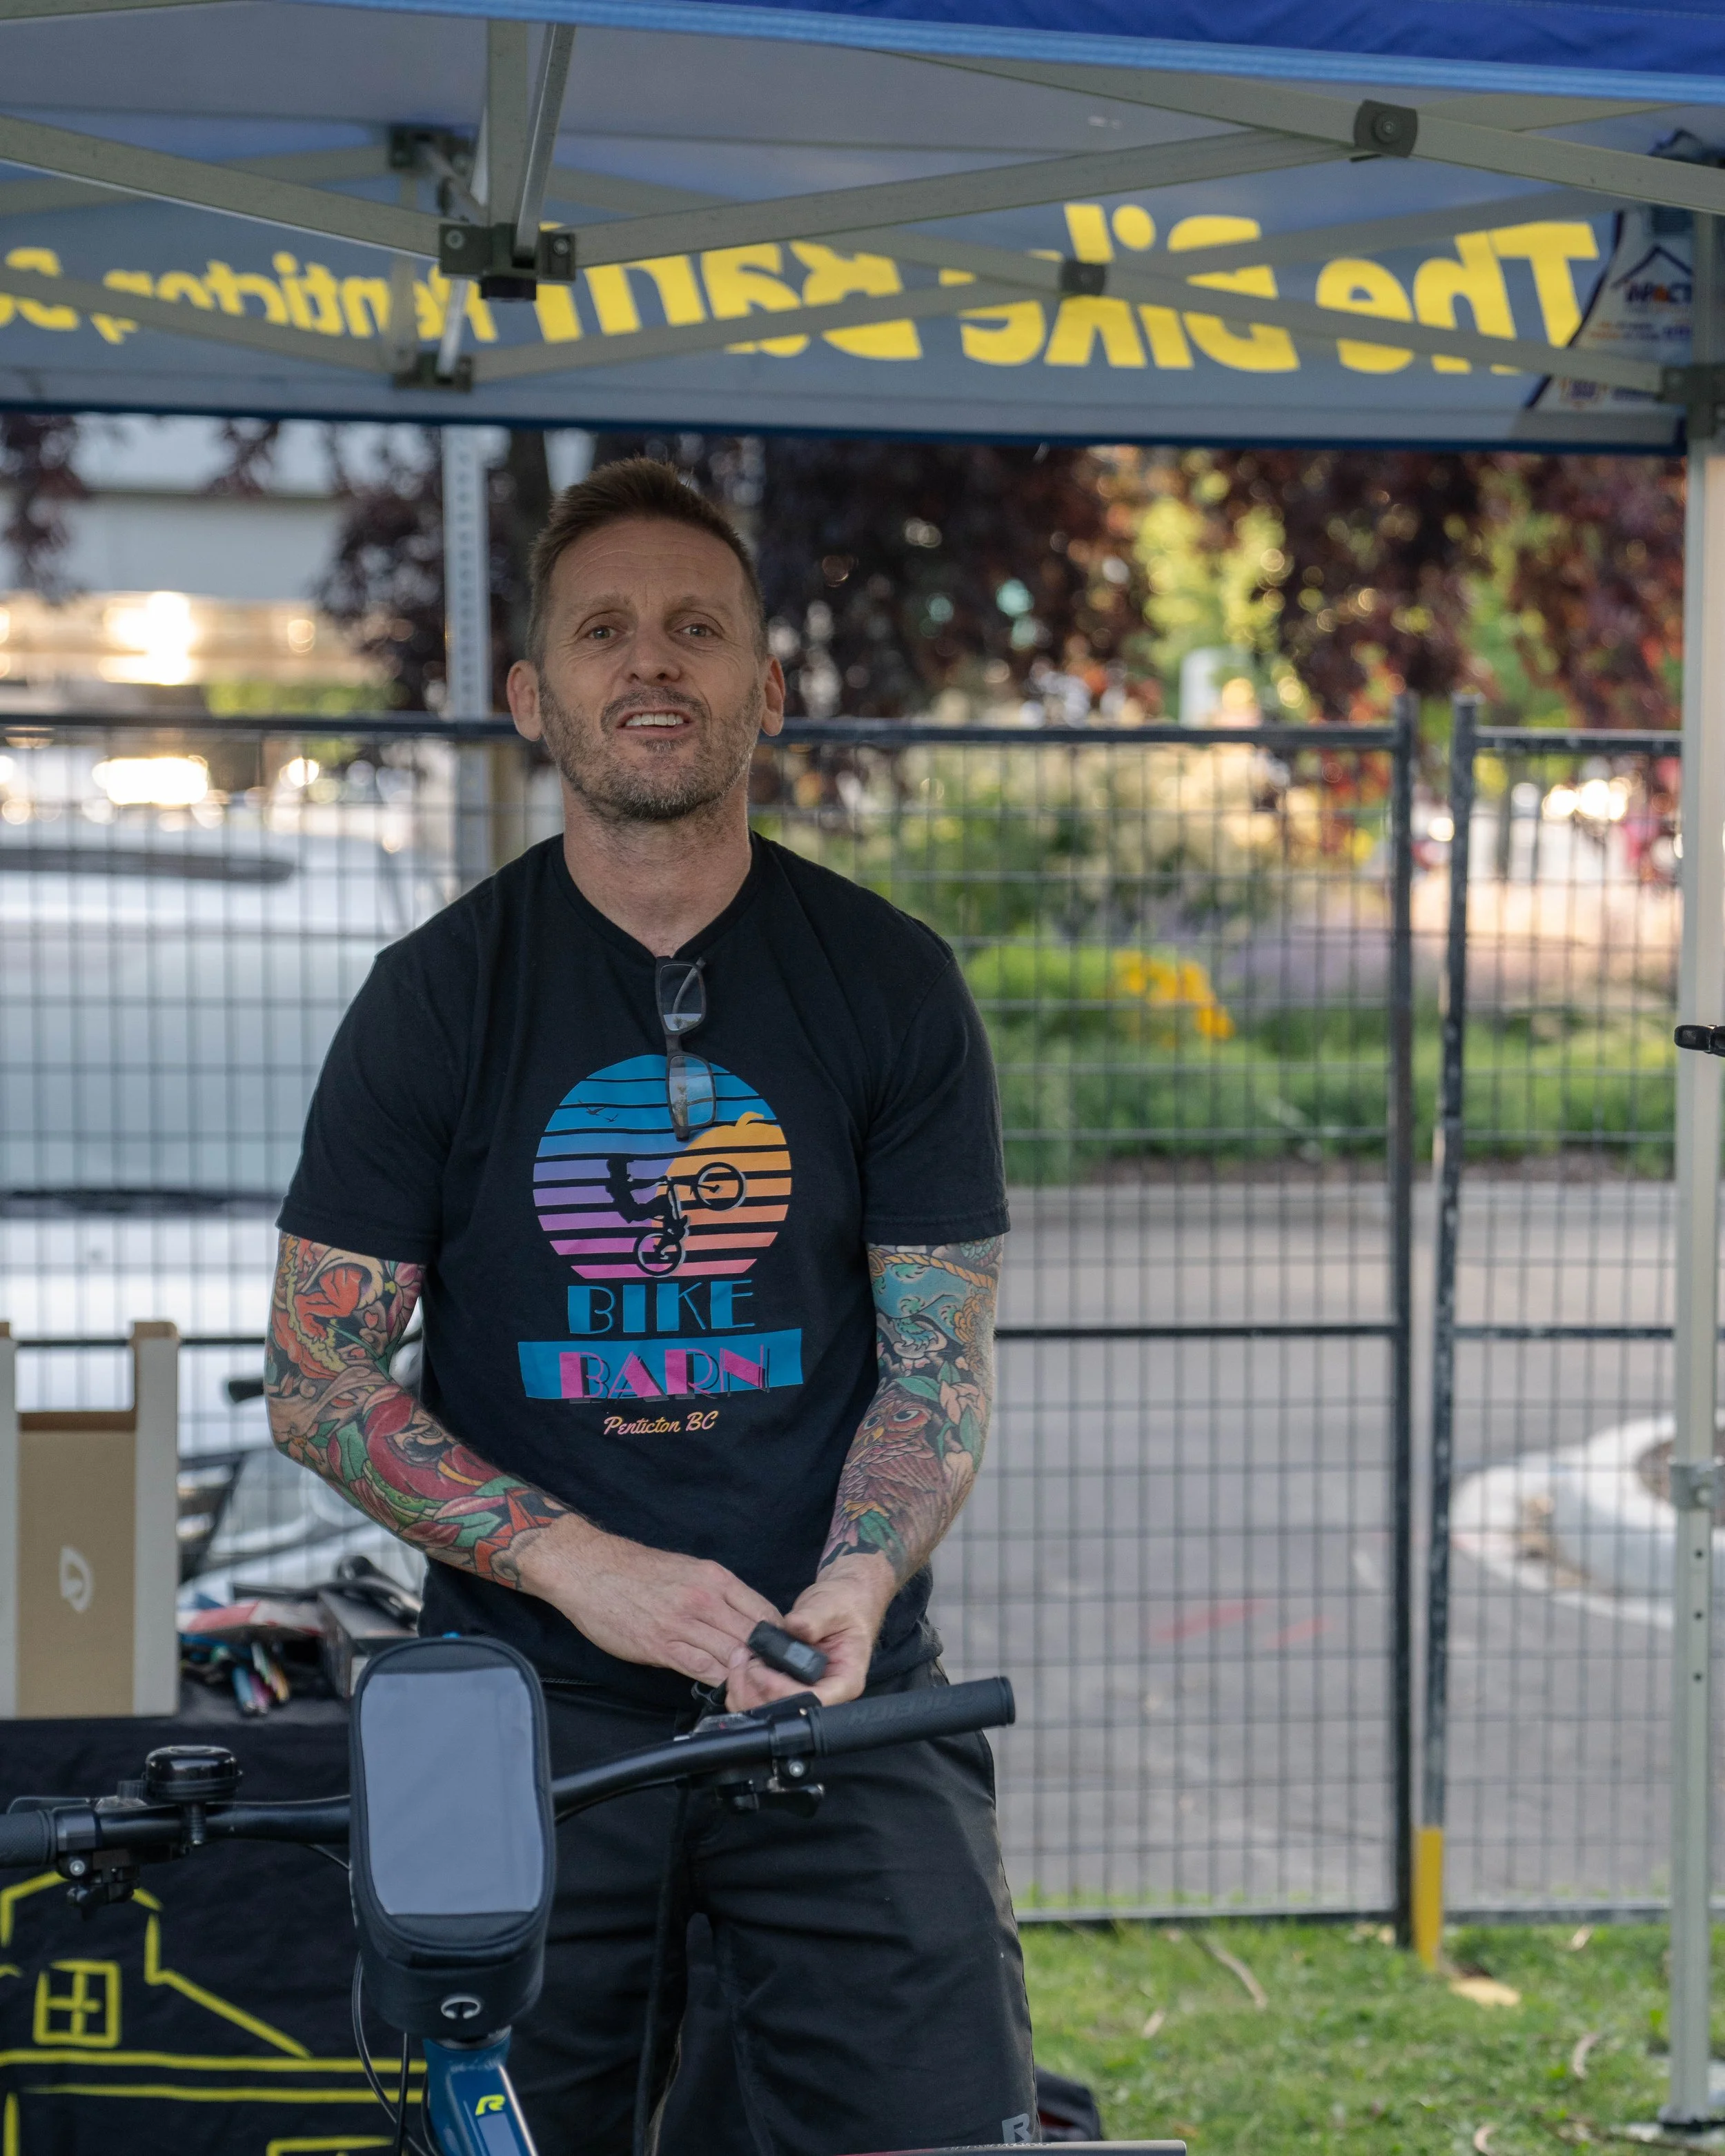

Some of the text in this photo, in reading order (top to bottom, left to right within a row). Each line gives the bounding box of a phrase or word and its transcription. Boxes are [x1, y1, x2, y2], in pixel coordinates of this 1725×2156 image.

[566, 1278, 756, 1334] BIKE
[559, 1344, 769, 1403] BARN
[603, 1410, 720, 1436] Penticton BC
